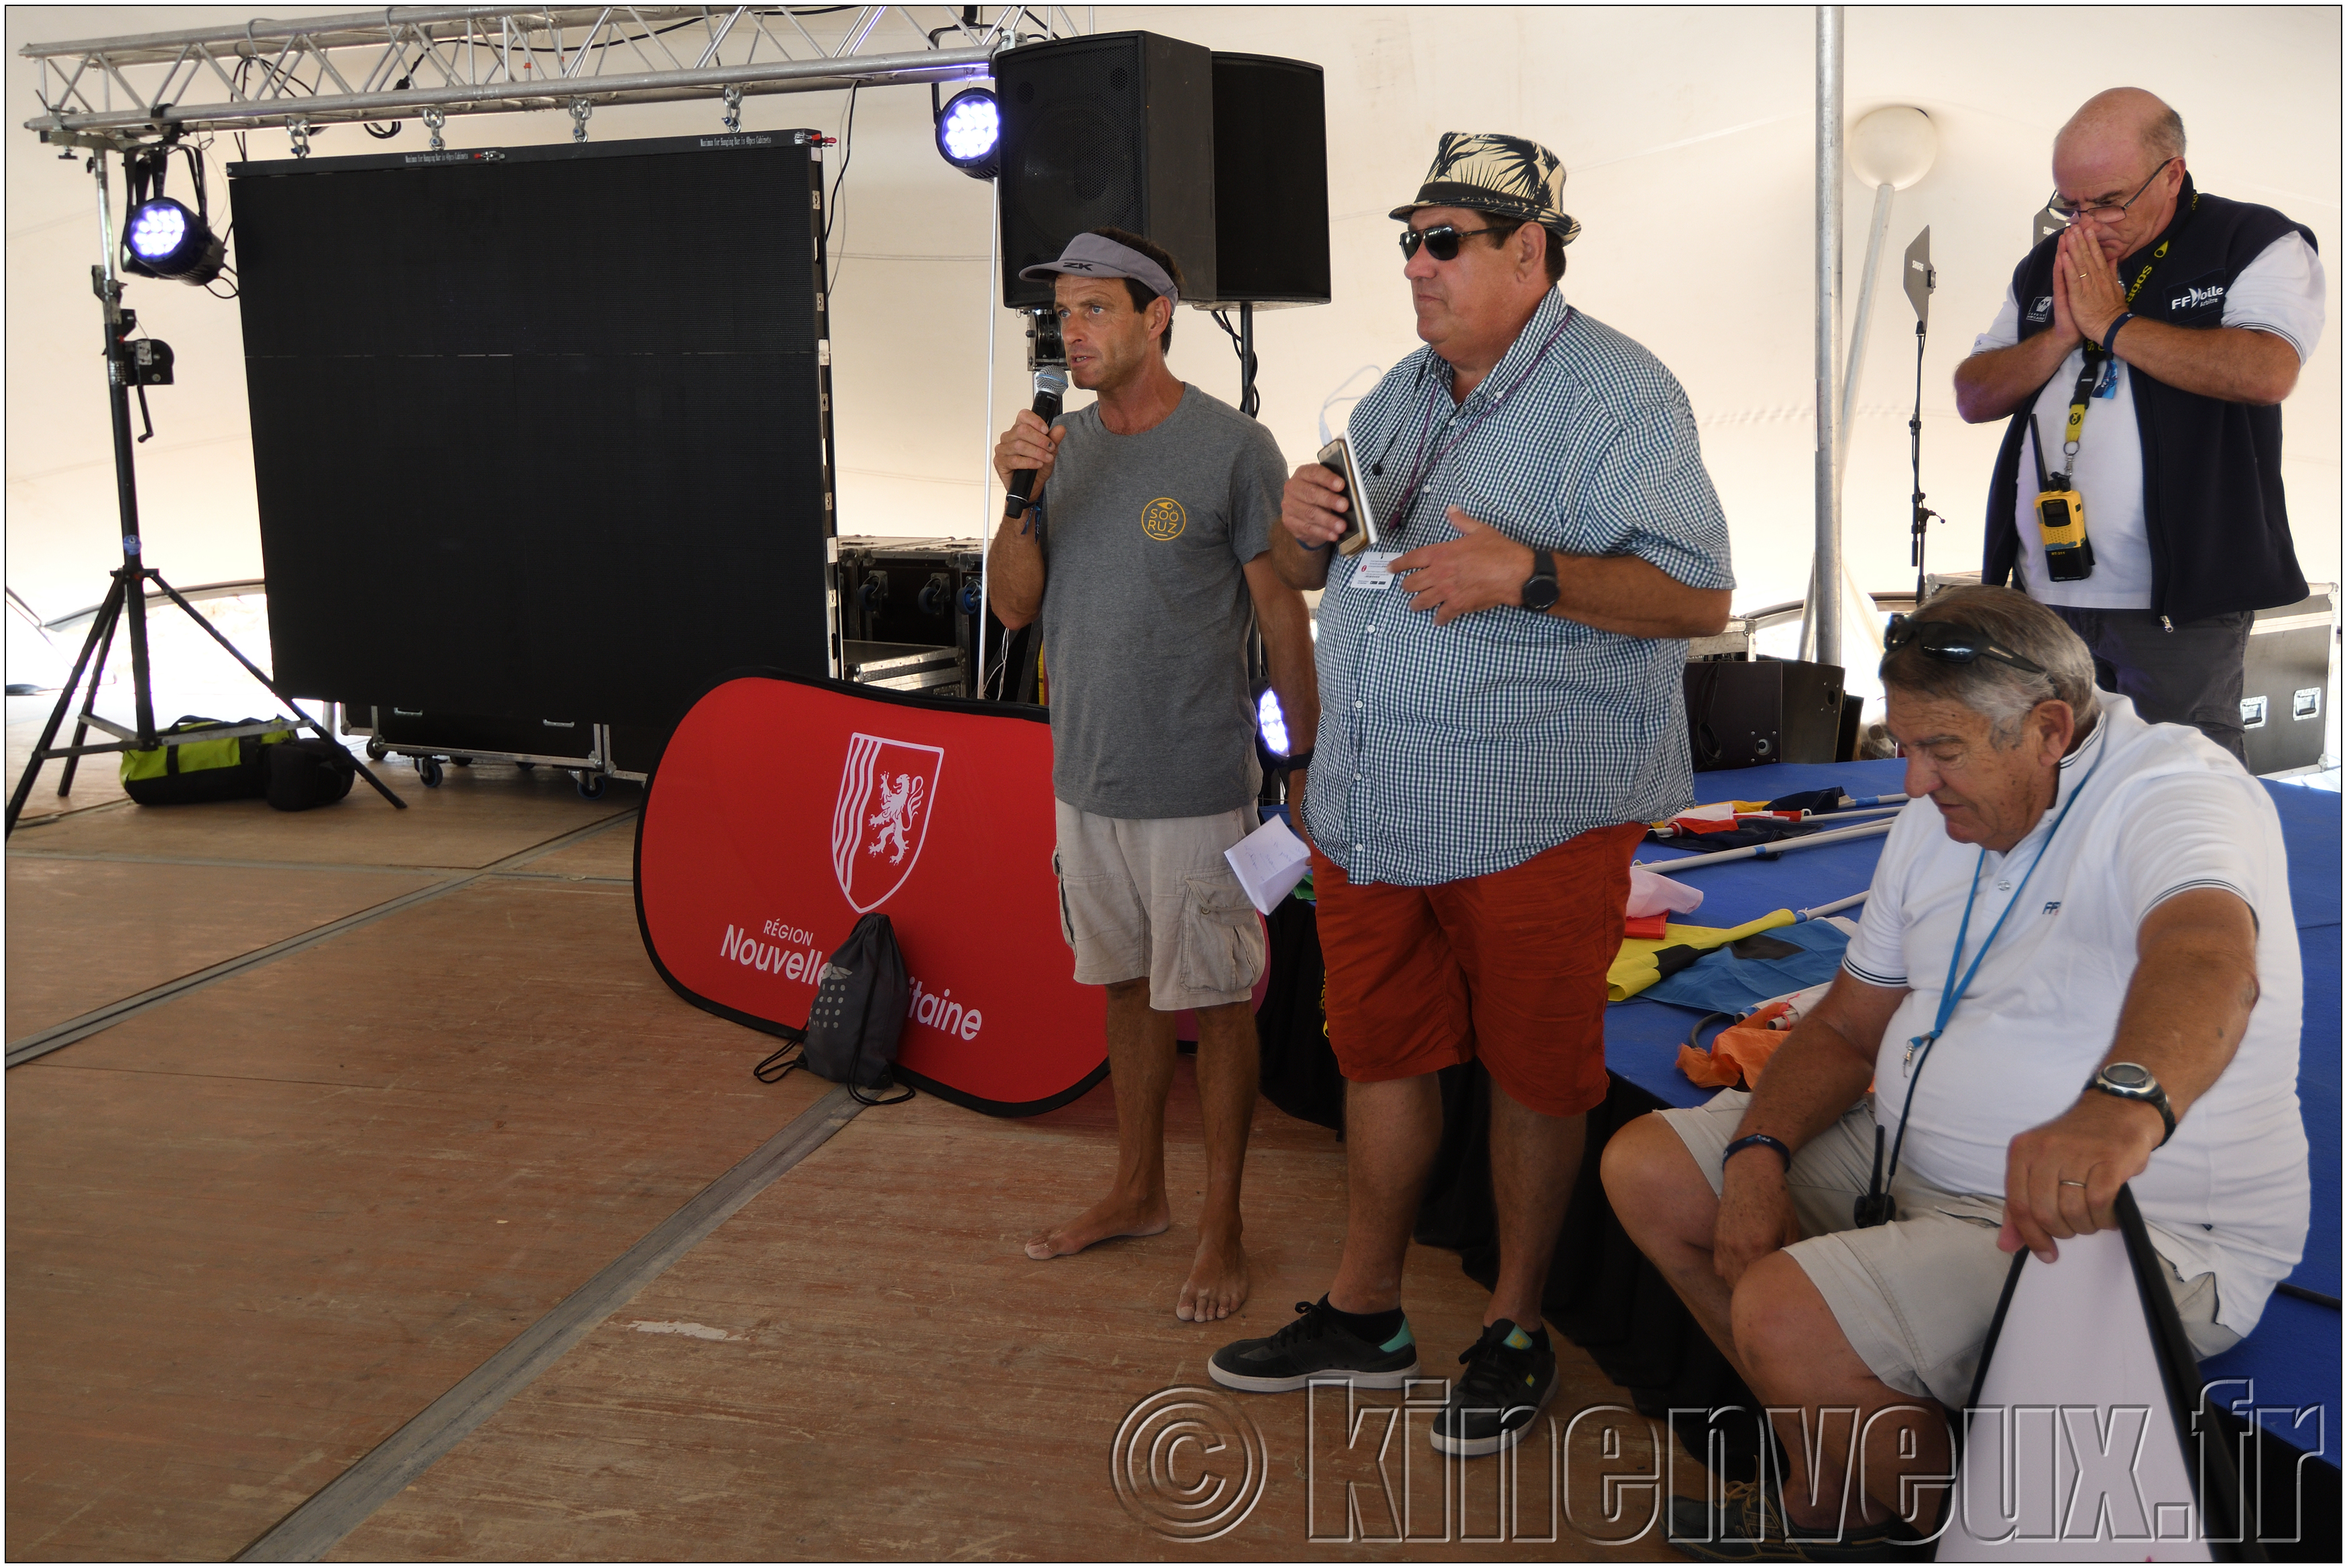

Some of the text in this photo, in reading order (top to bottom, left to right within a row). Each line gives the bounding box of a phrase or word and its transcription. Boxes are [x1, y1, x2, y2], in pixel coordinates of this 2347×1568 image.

[2199, 298, 2218, 308] Arbitre
[1147, 520, 1177, 534] RUZ
[763, 918, 813, 946] RÉGION
